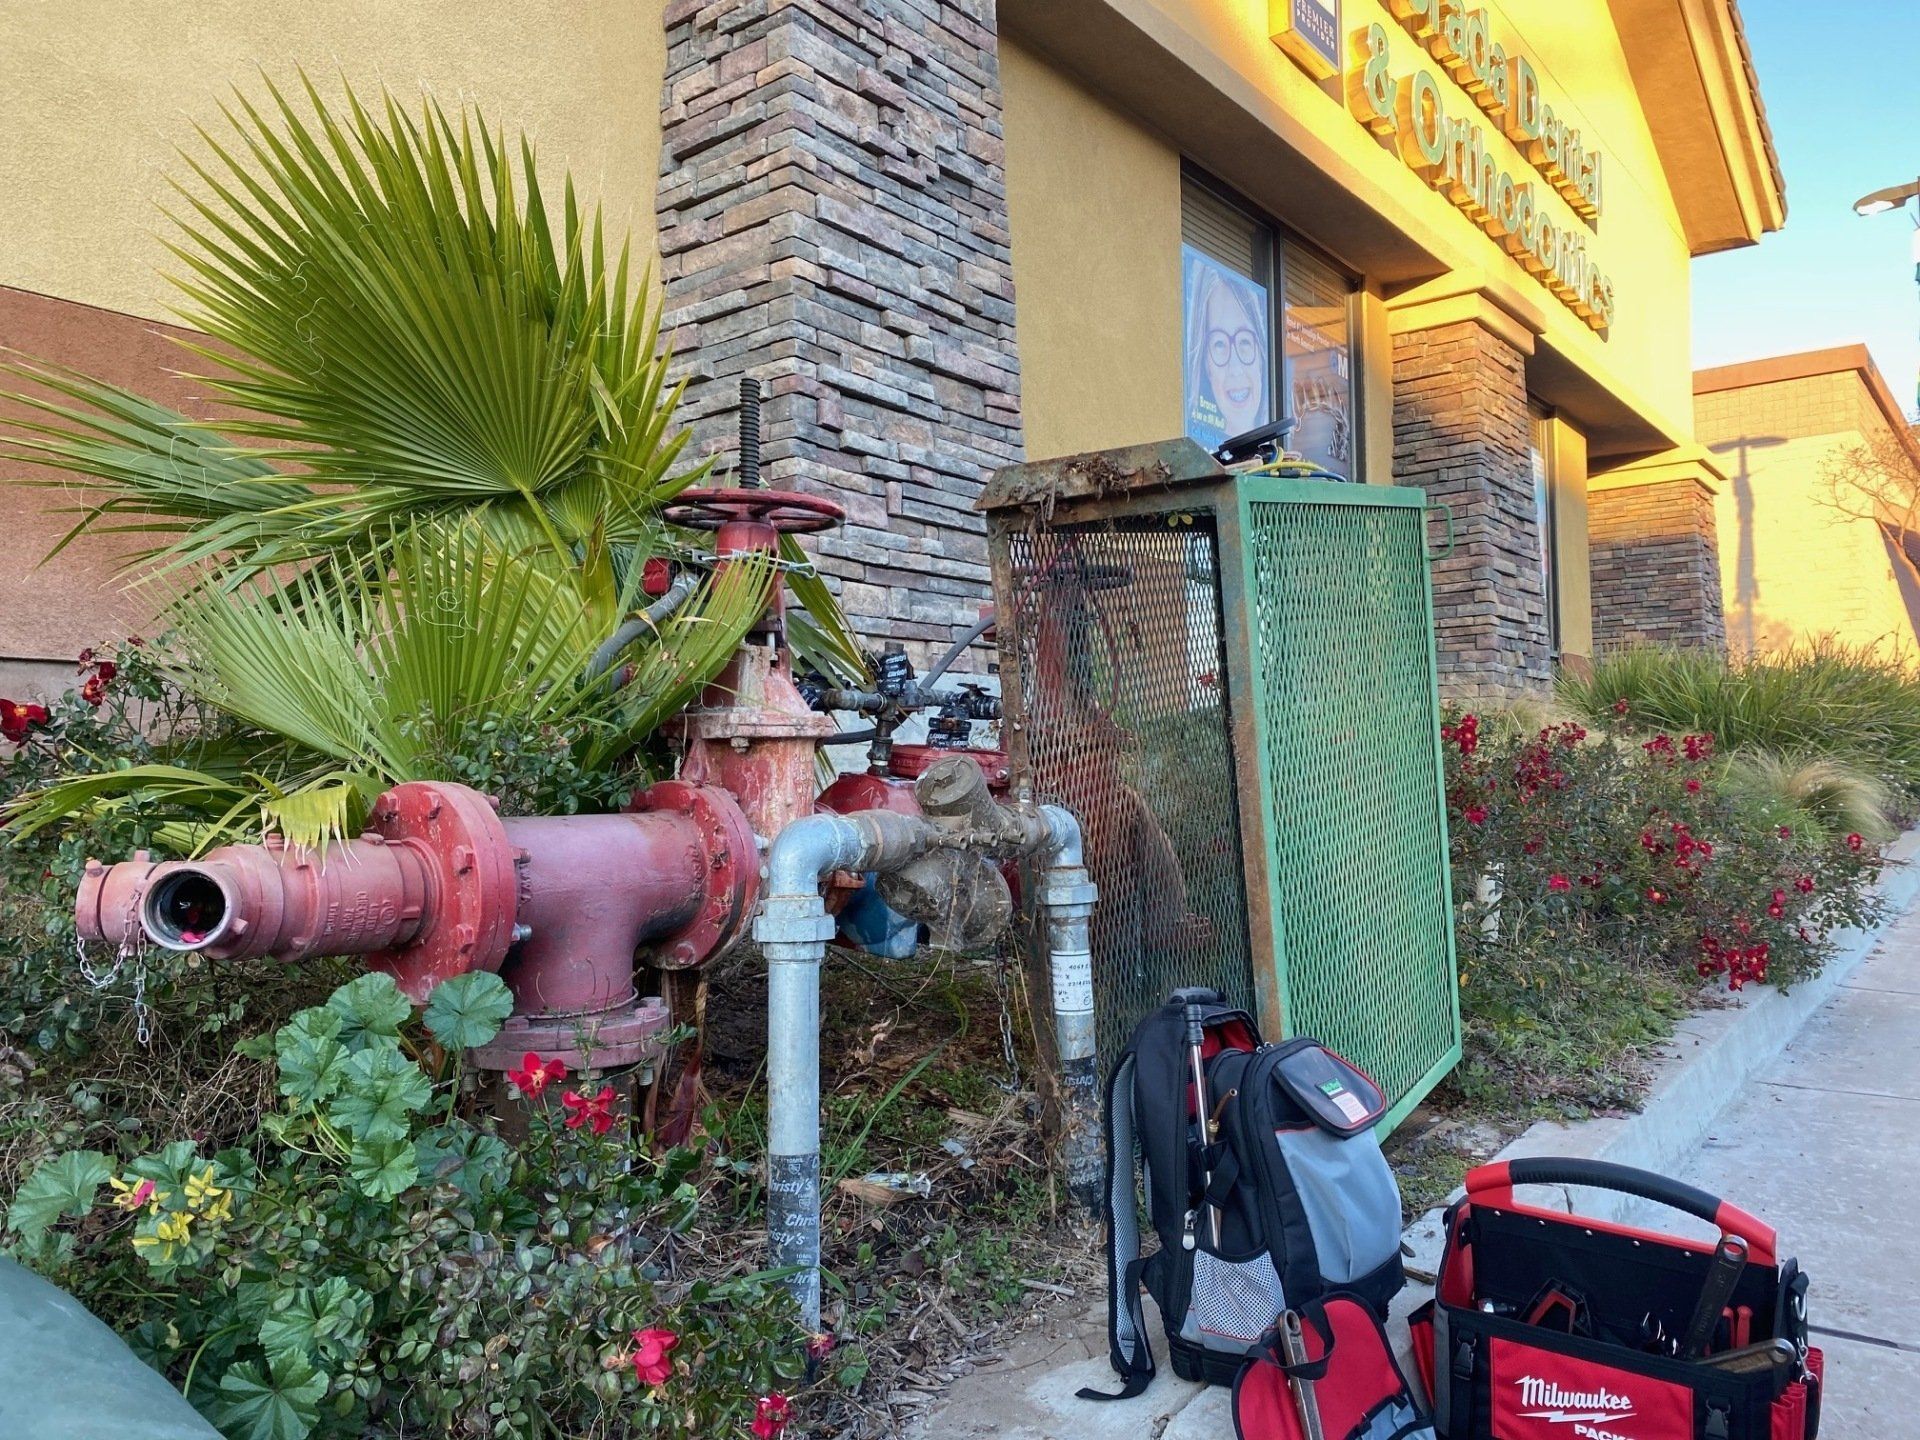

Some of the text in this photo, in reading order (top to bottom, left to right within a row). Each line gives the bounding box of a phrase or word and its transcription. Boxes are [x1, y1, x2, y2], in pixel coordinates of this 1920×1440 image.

[1296, 8, 1335, 50] PROVIDER
[1364, 22, 1615, 329] & Orthodontics
[1516, 54, 1603, 217] Dental
[1514, 1375, 1633, 1410] Milwaukee
